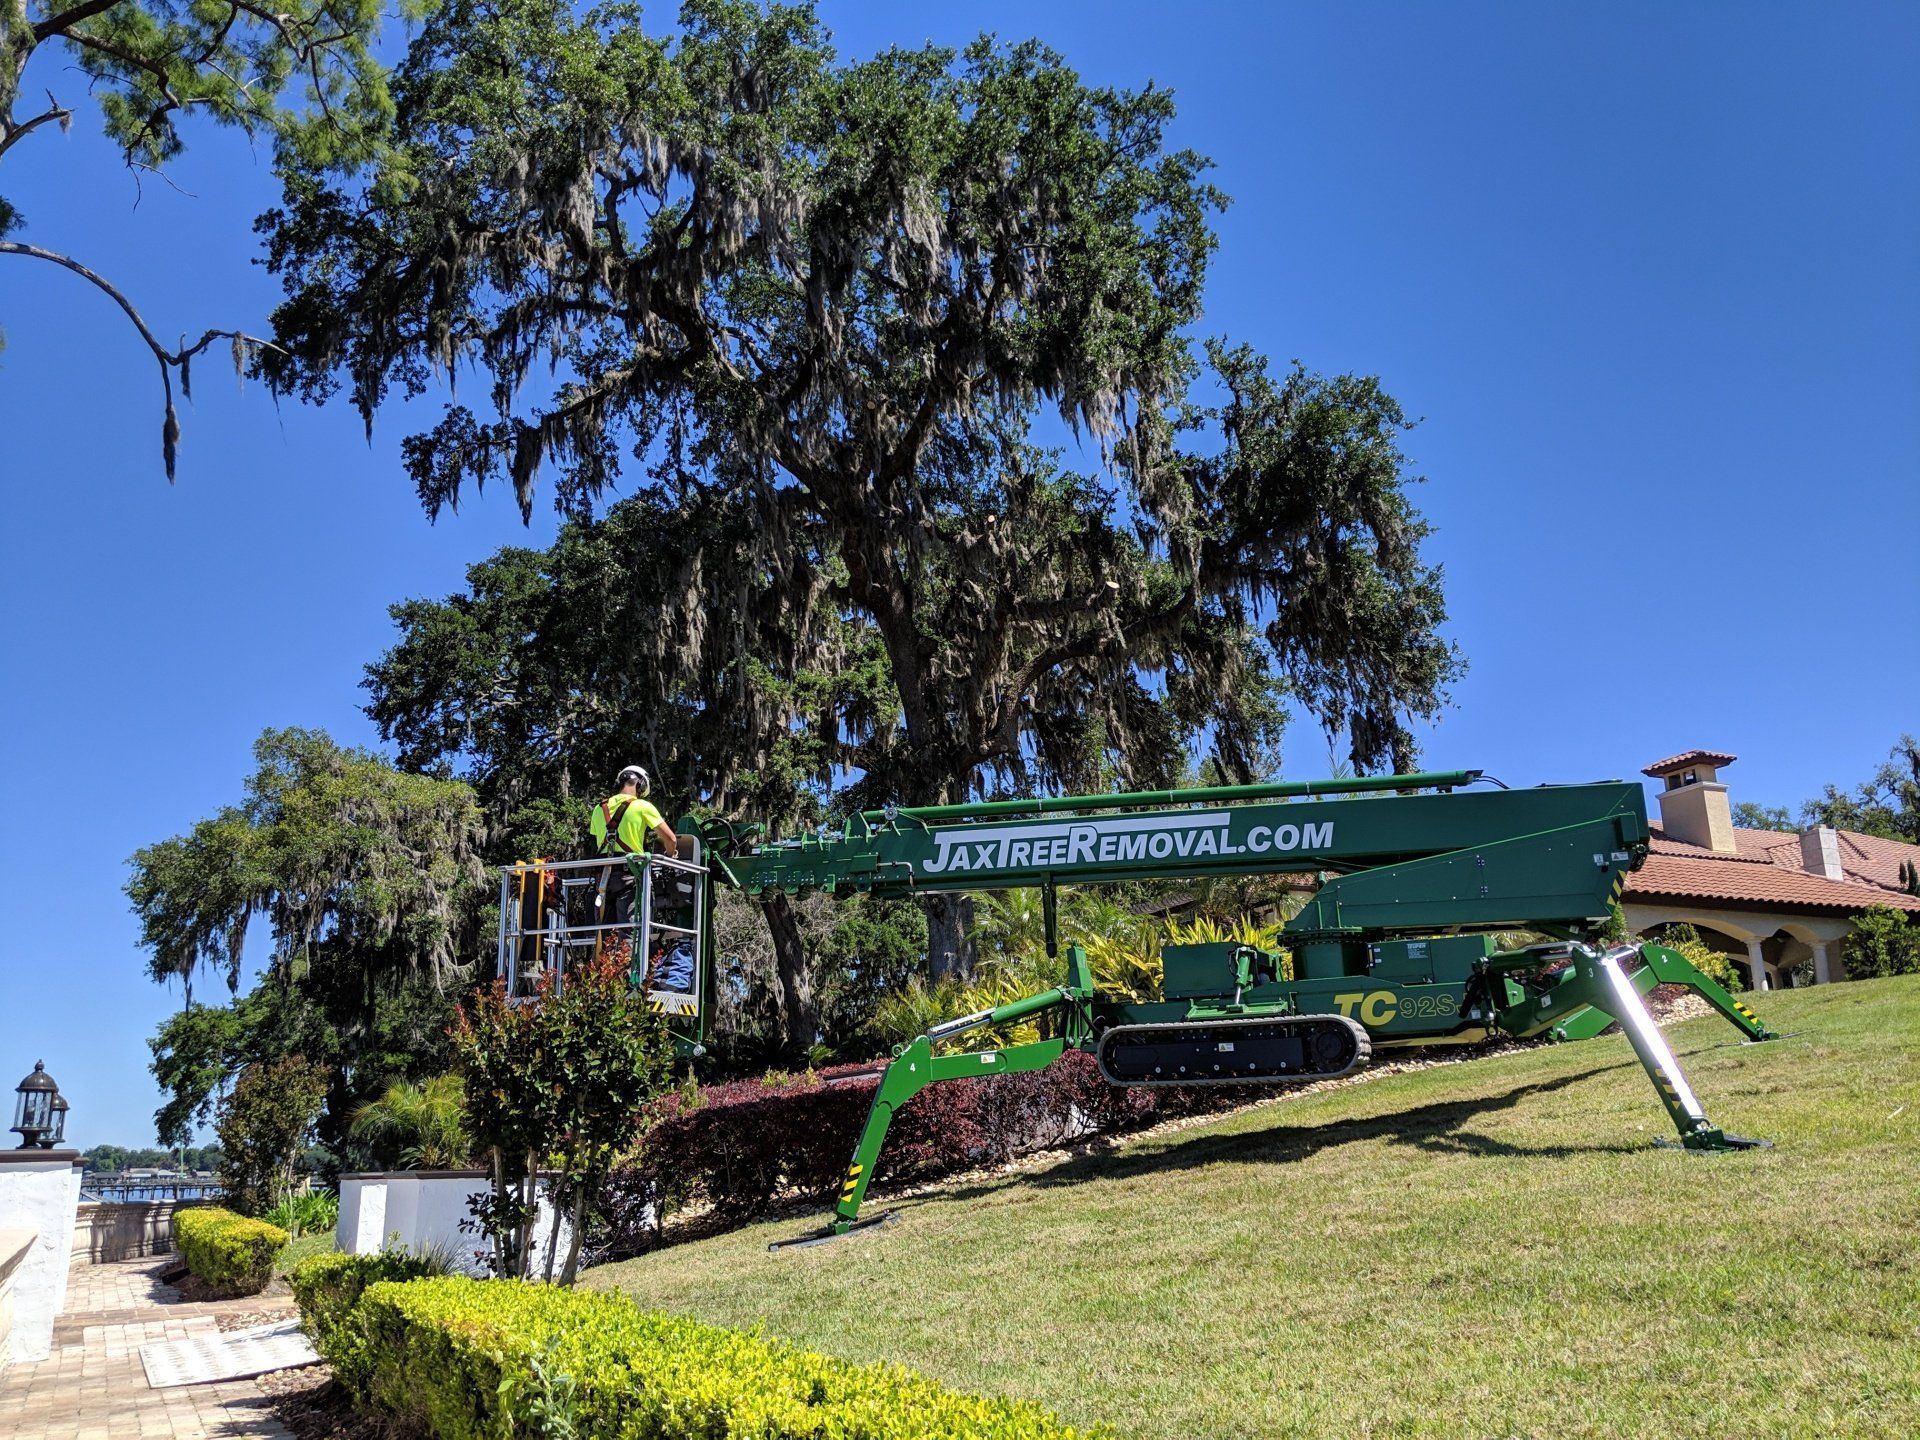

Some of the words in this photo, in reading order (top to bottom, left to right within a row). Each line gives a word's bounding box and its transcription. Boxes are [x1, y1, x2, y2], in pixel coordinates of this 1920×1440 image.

[1661, 955, 1668, 963] 2
[1588, 968, 1594, 978] 3
[1333, 991, 1397, 1026] TC
[910, 1063, 916, 1072] 4
